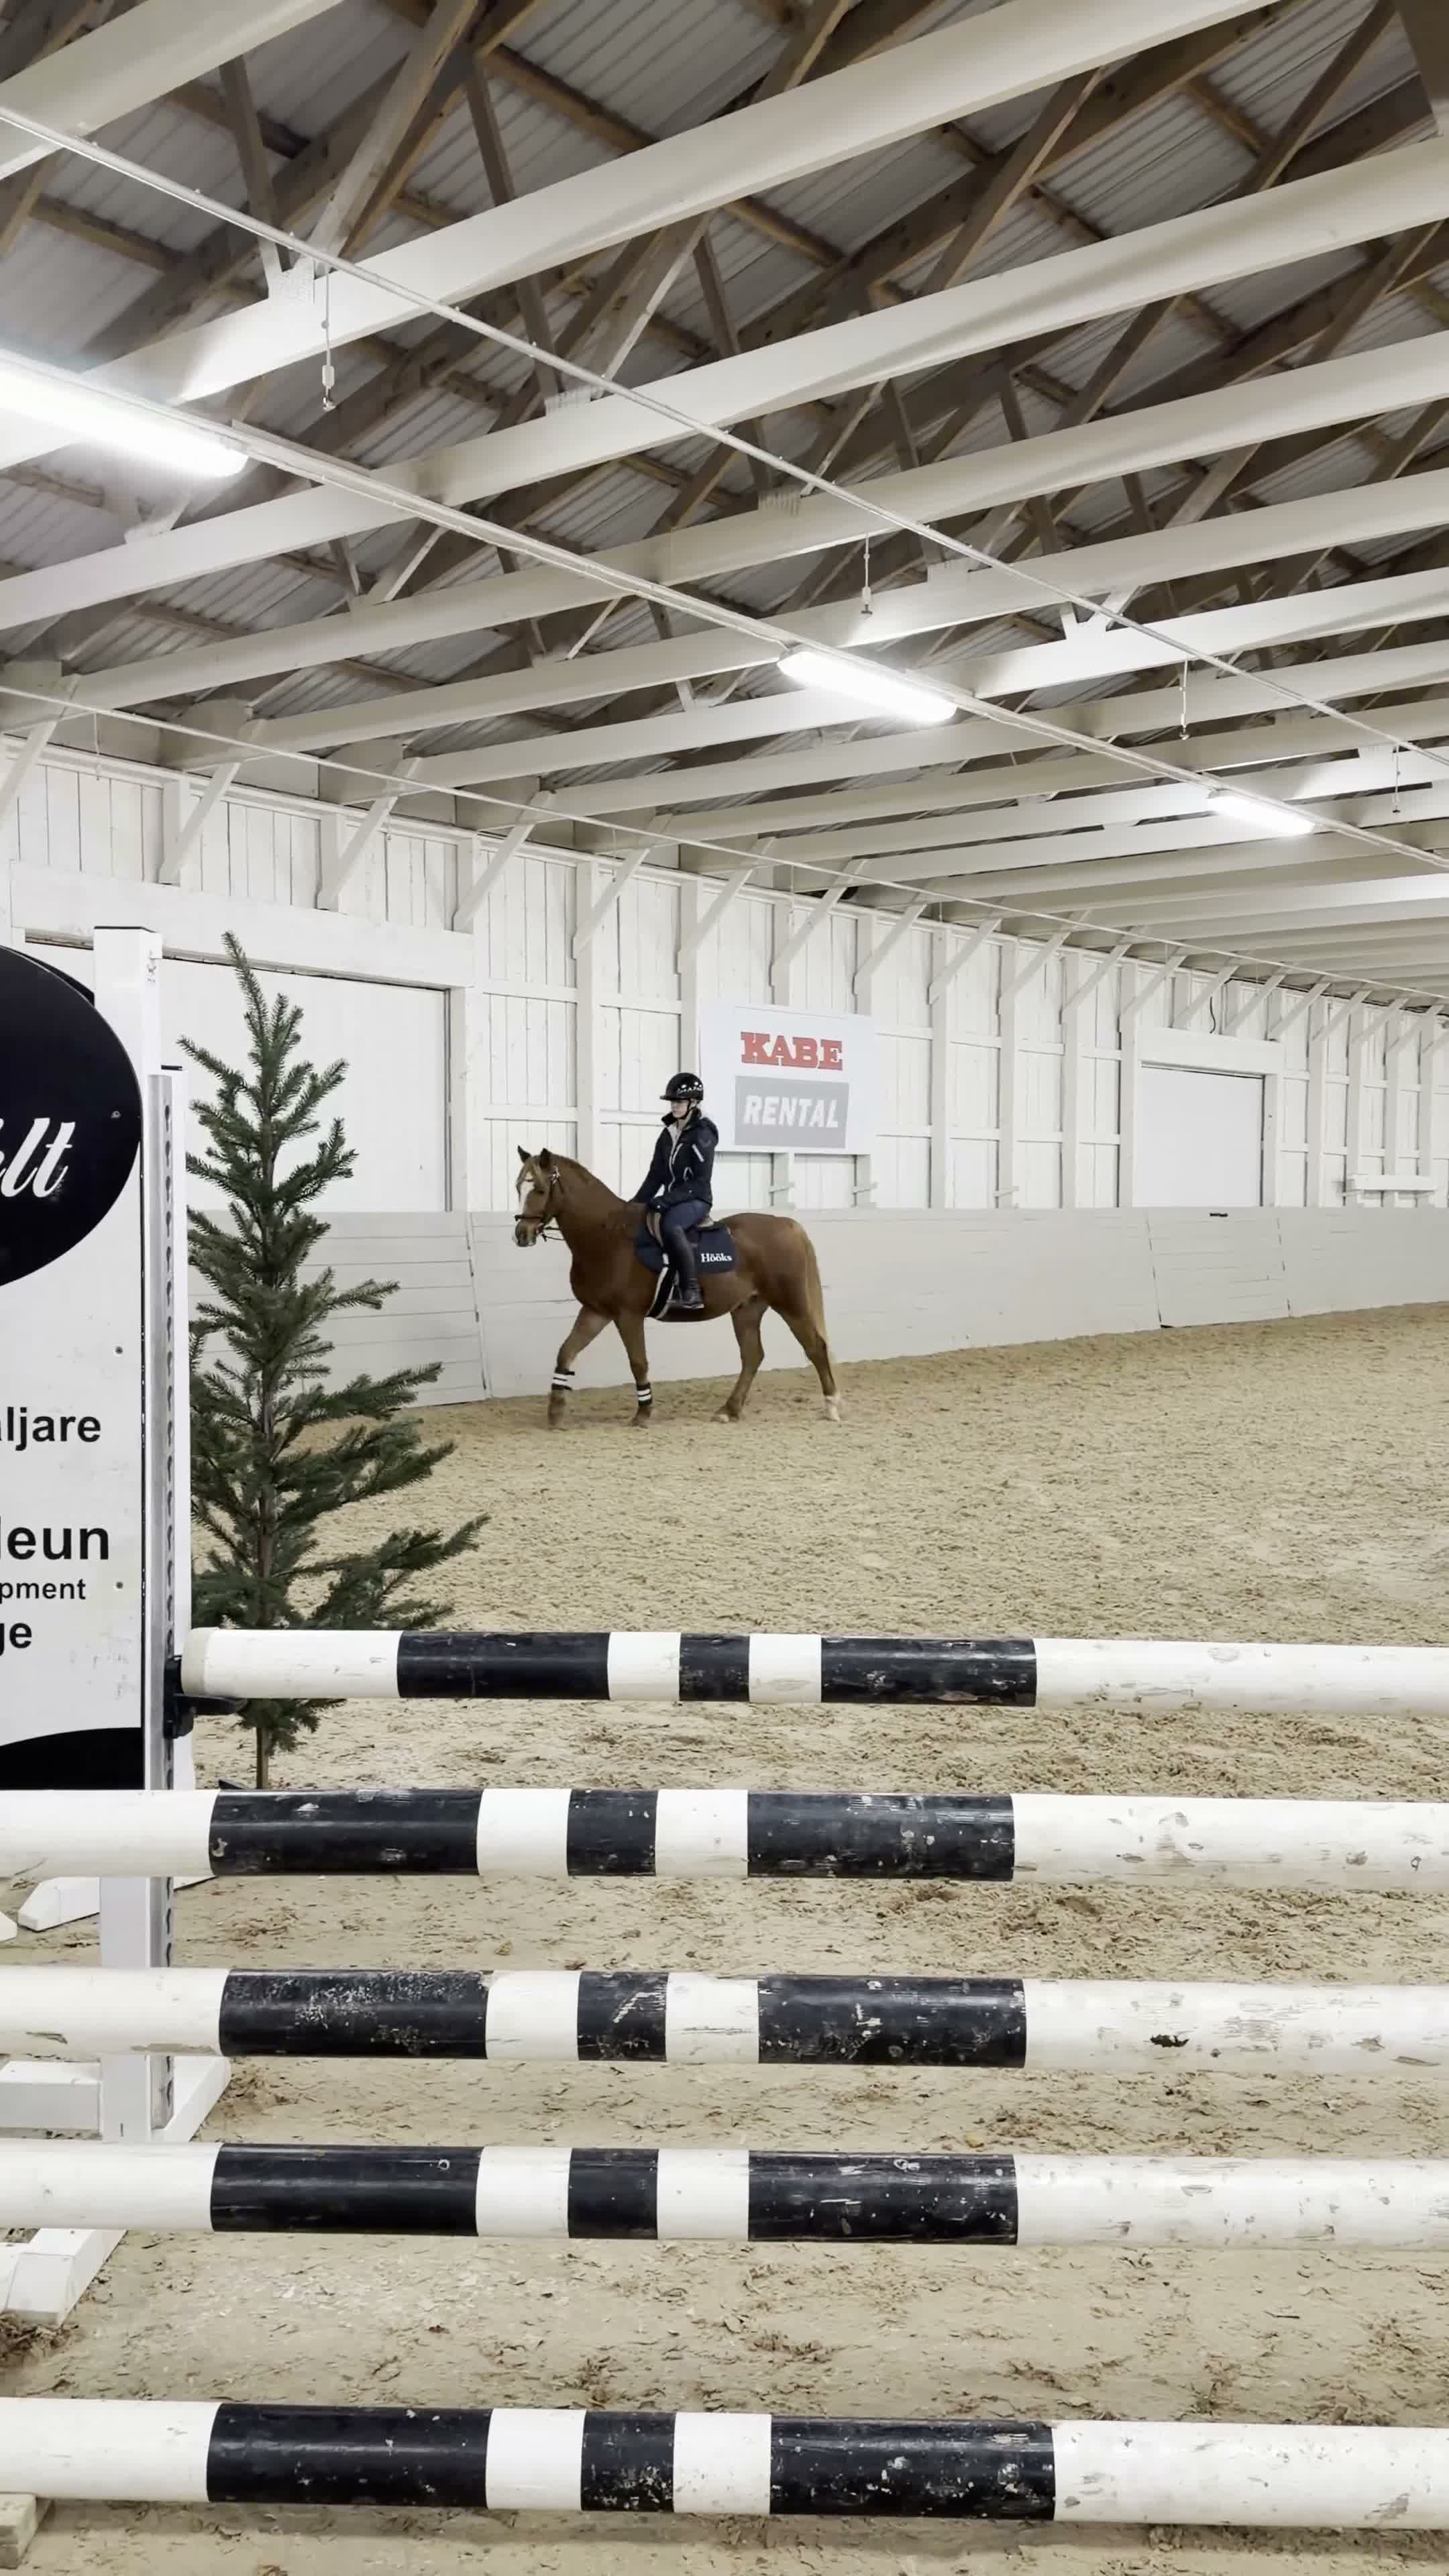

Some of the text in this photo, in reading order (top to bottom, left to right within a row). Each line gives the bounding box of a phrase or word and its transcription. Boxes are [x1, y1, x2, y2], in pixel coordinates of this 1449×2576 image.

[741, 1031, 843, 1071] KABE
[743, 1095, 839, 1128] RENTAL
[0, 1118, 75, 1197] lt
[0, 1406, 101, 1451] ljare
[0, 1516, 109, 1560] eun
